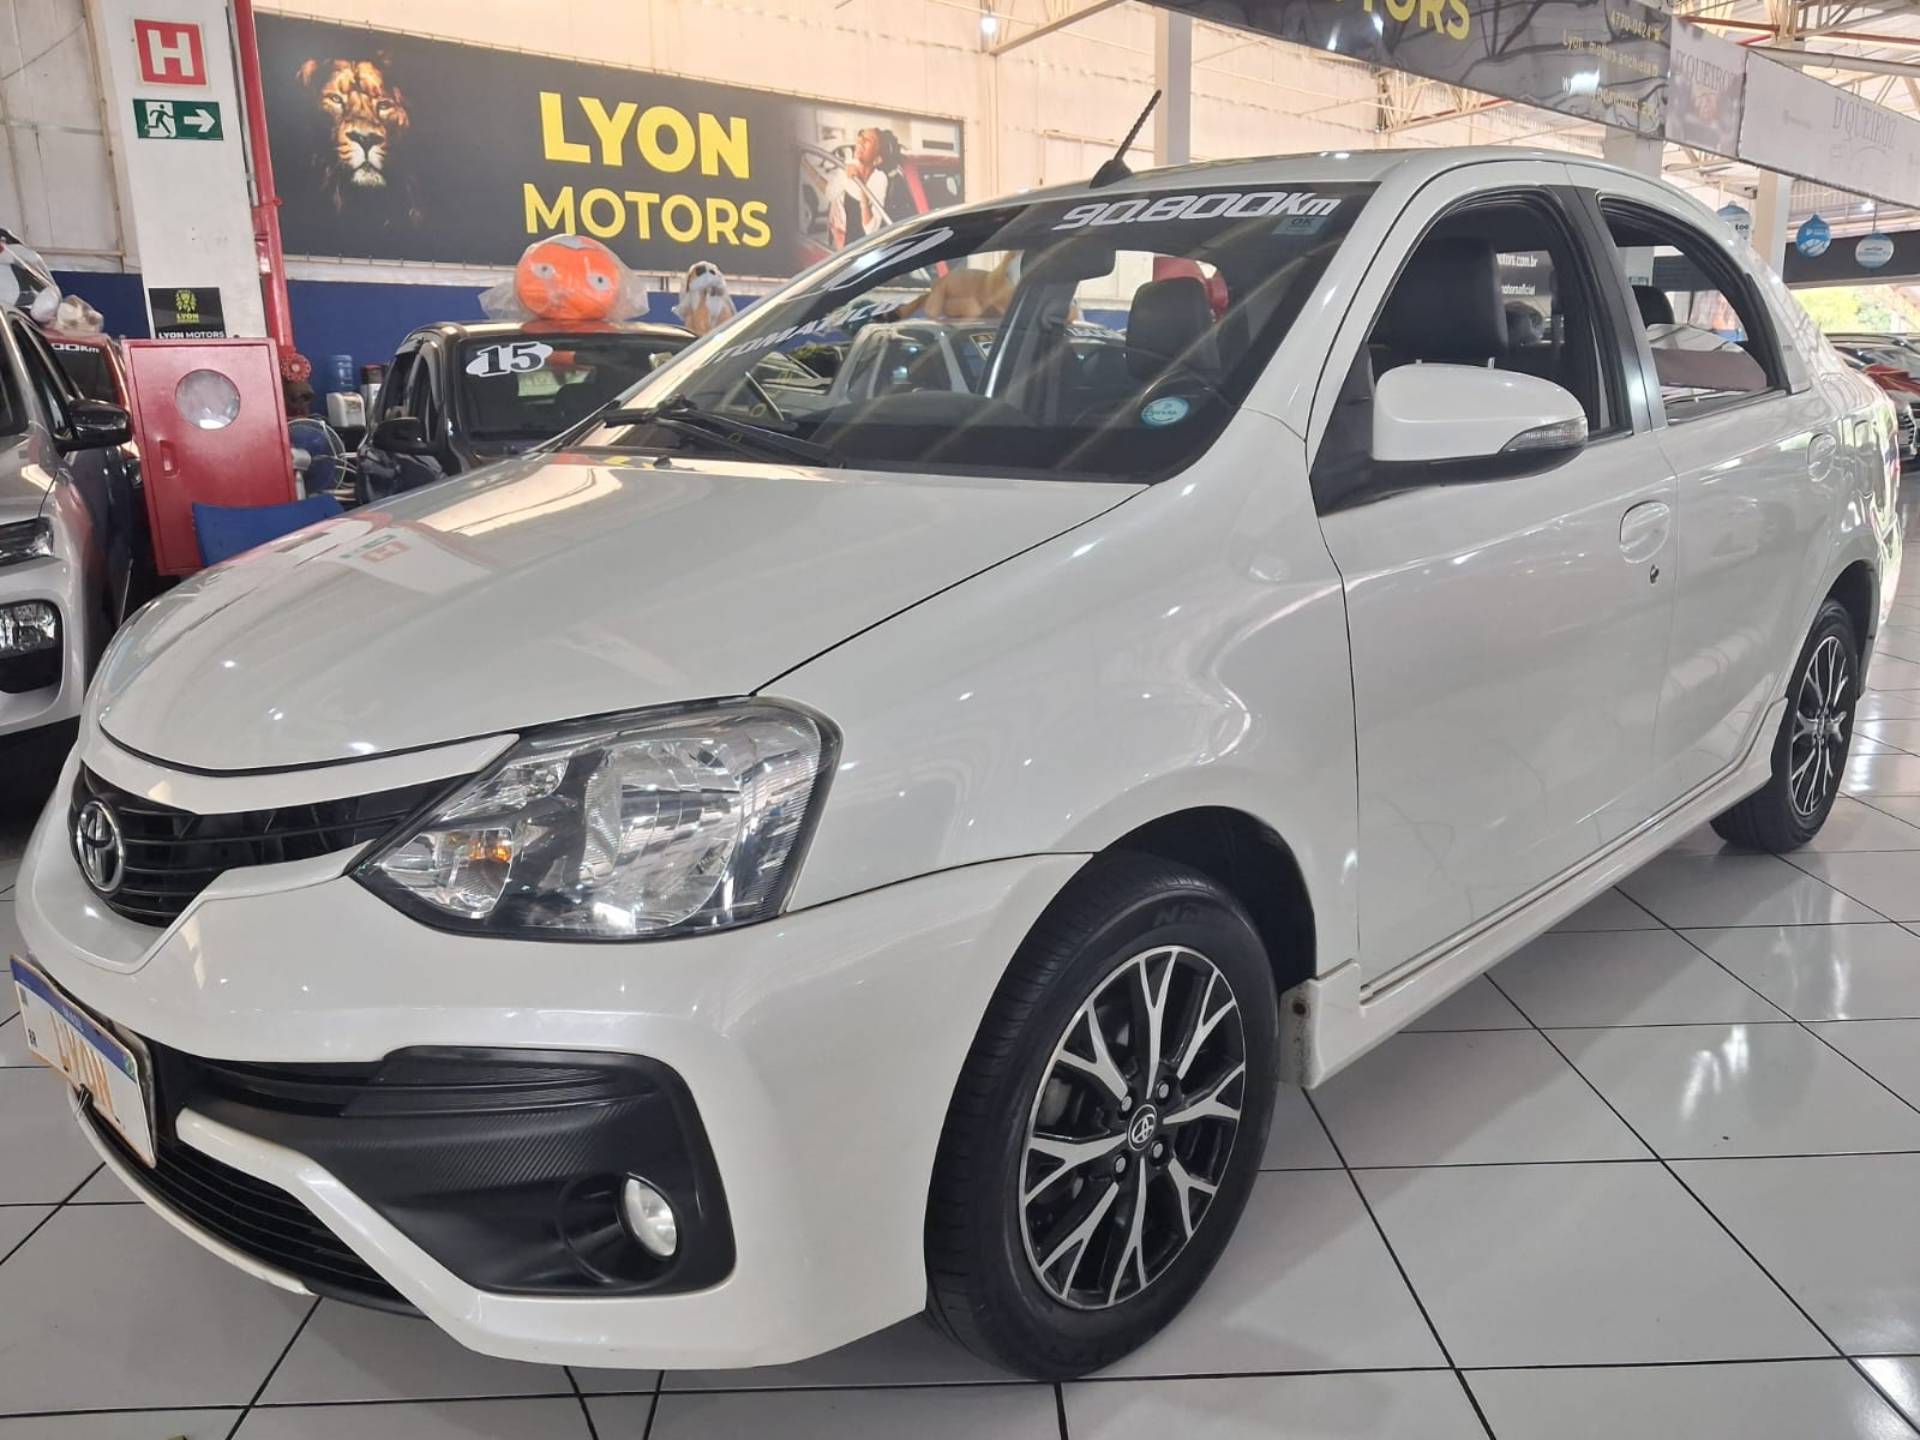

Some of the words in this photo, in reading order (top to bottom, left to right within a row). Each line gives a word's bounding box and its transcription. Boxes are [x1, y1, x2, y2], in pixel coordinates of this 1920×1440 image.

[148, 30, 194, 77] H
[539, 91, 750, 179] LYON
[523, 183, 772, 247] MOTORS
[478, 341, 545, 377] 15
